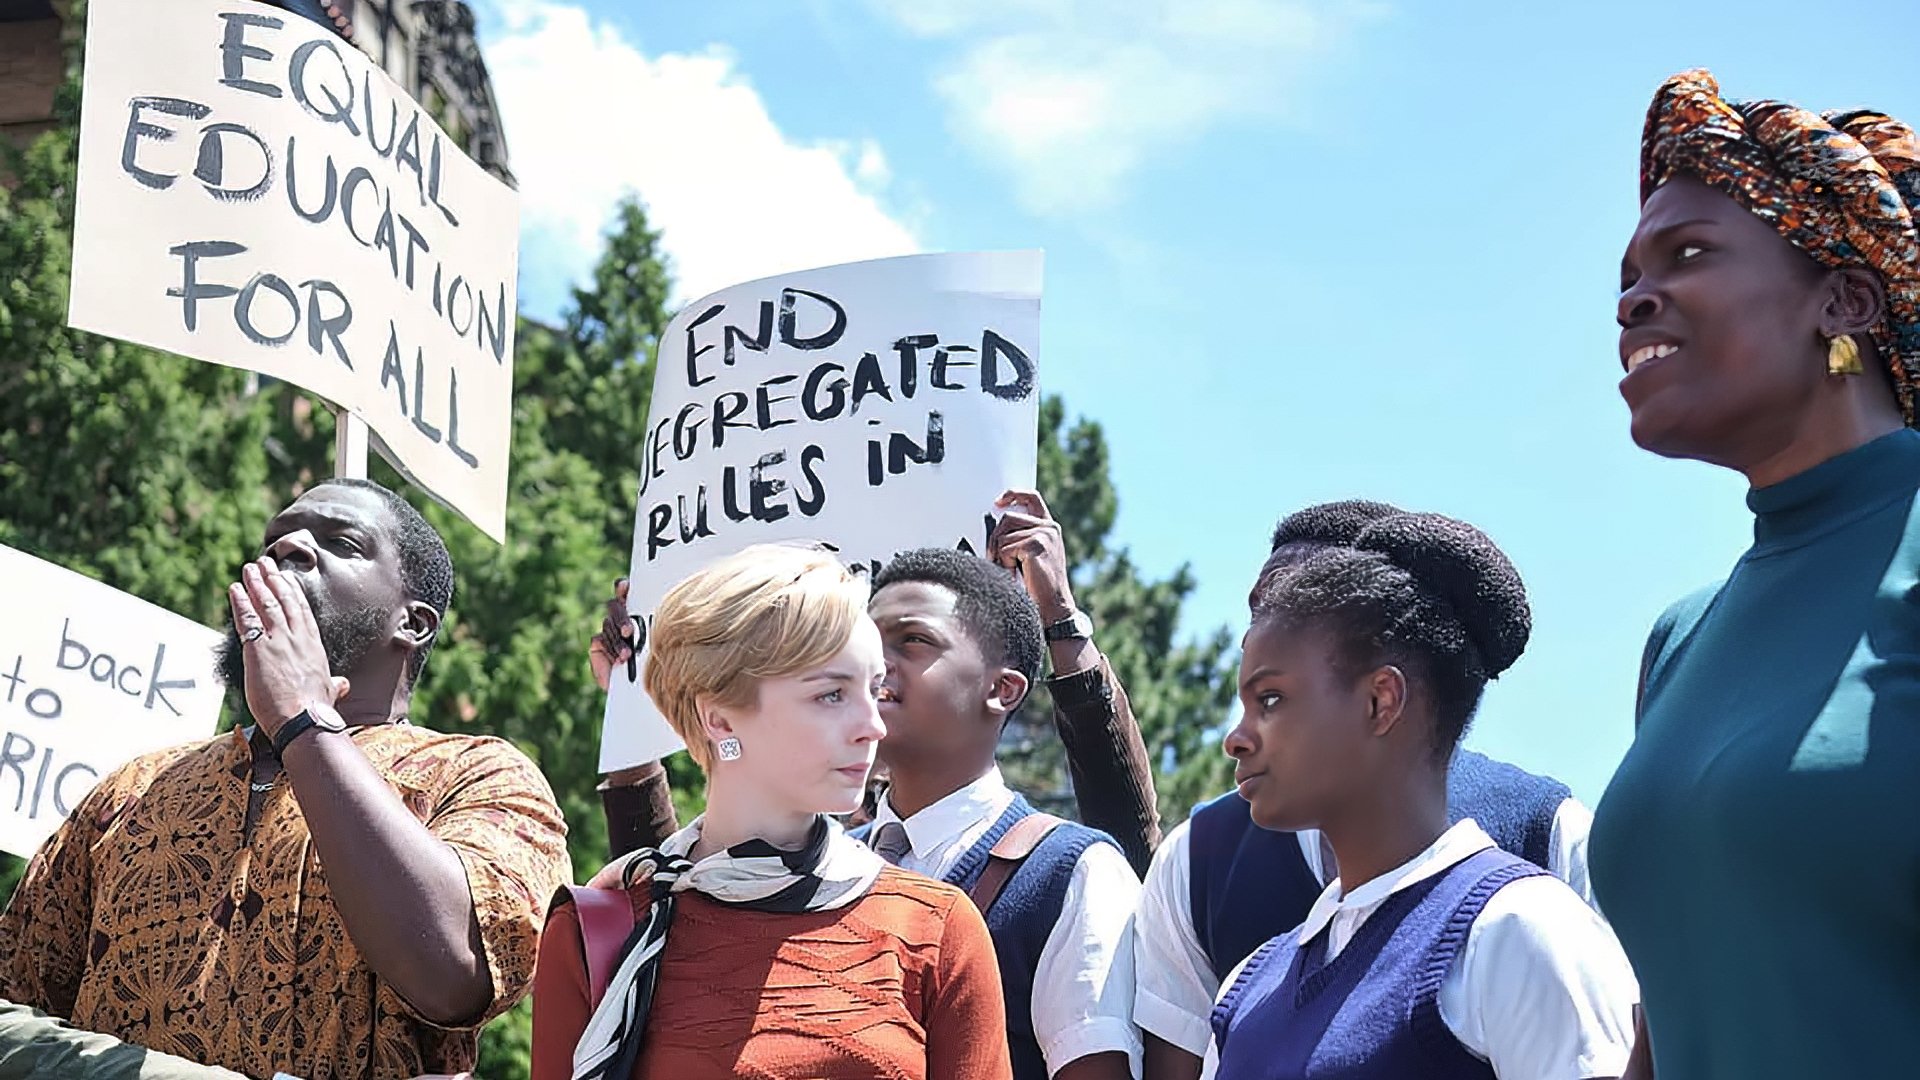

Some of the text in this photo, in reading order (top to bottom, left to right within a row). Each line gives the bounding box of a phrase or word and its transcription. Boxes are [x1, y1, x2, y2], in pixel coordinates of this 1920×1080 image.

[218, 12, 459, 227] EQUAL
[121, 96, 506, 365] EDUCATION
[166, 240, 479, 469] FOR ALL
[686, 287, 847, 387] END
[647, 444, 827, 561] RULES
[1, 655, 62, 719] to
[56, 617, 196, 716] back
